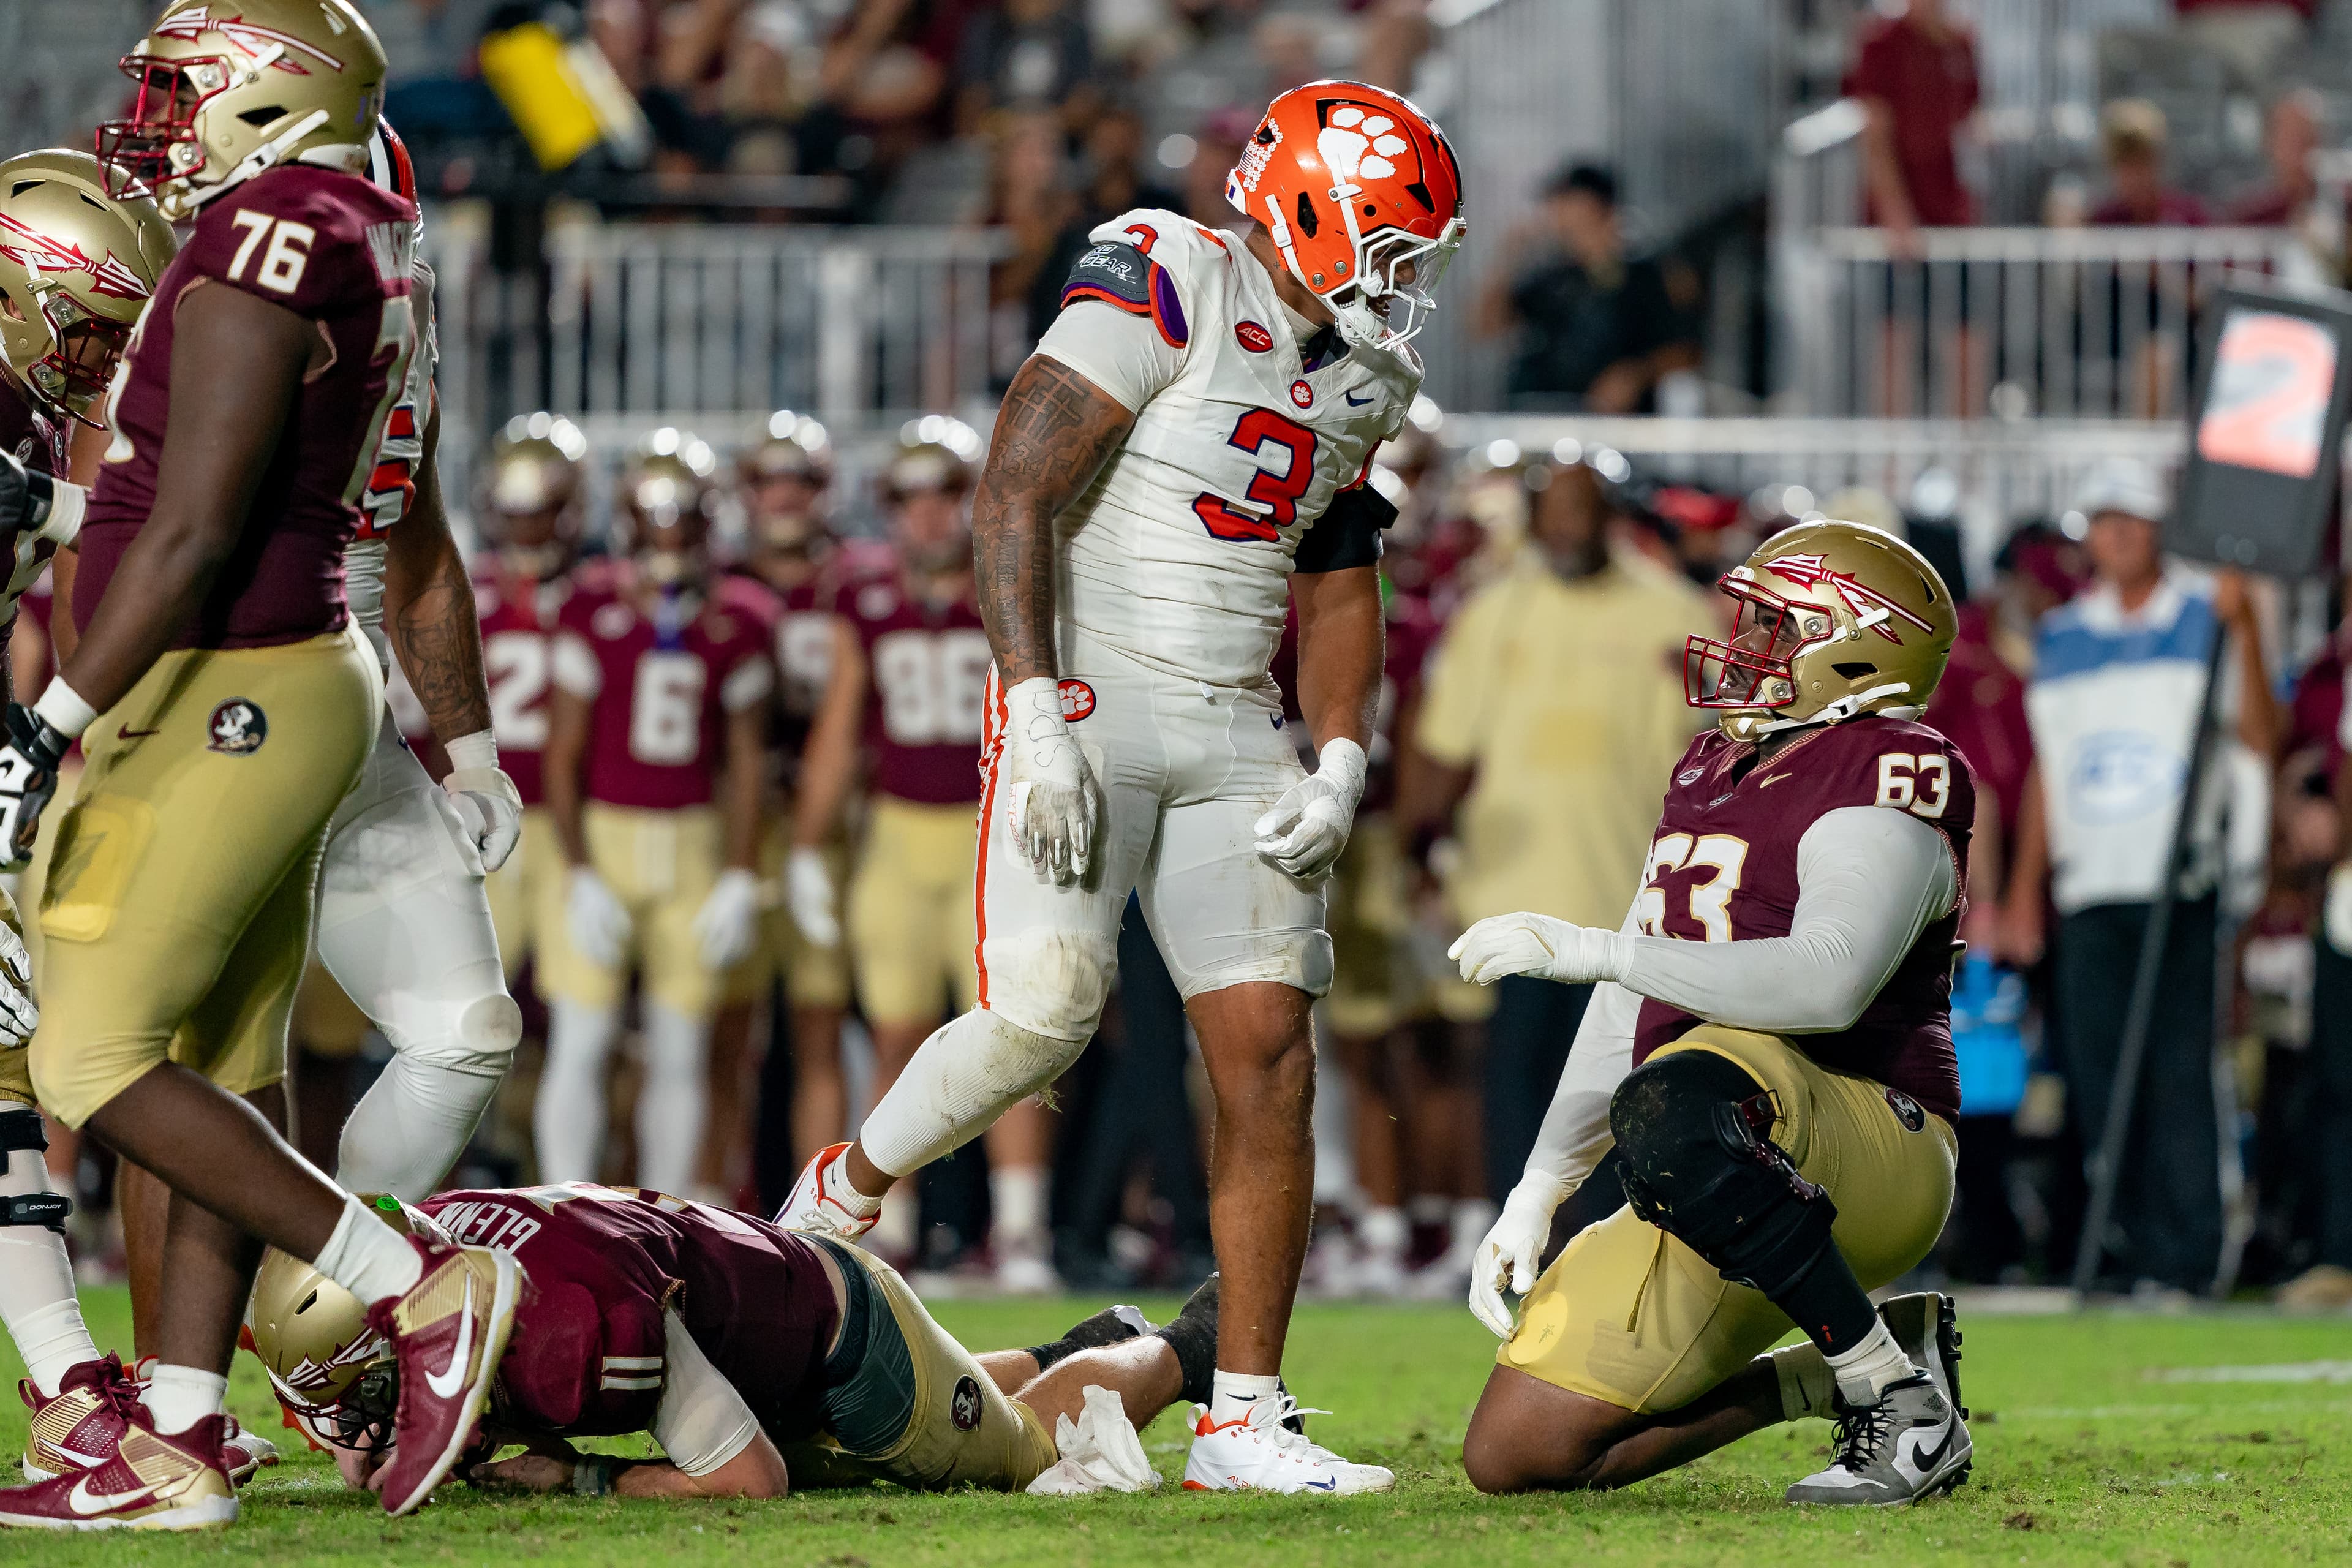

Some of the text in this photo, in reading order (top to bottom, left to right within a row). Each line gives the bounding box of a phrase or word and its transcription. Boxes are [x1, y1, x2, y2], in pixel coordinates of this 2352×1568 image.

[227, 208, 316, 294] 76
[1080, 254, 1132, 274] GEAR
[1238, 327, 1270, 345] ACC
[2197, 312, 2335, 479] 2
[1192, 406, 1319, 542] 3
[626, 649, 708, 767] 6
[1874, 753, 1950, 818] 63
[1637, 832, 1749, 943] 63
[433, 1202, 541, 1256] GLENN
[599, 1356, 663, 1391] 11
